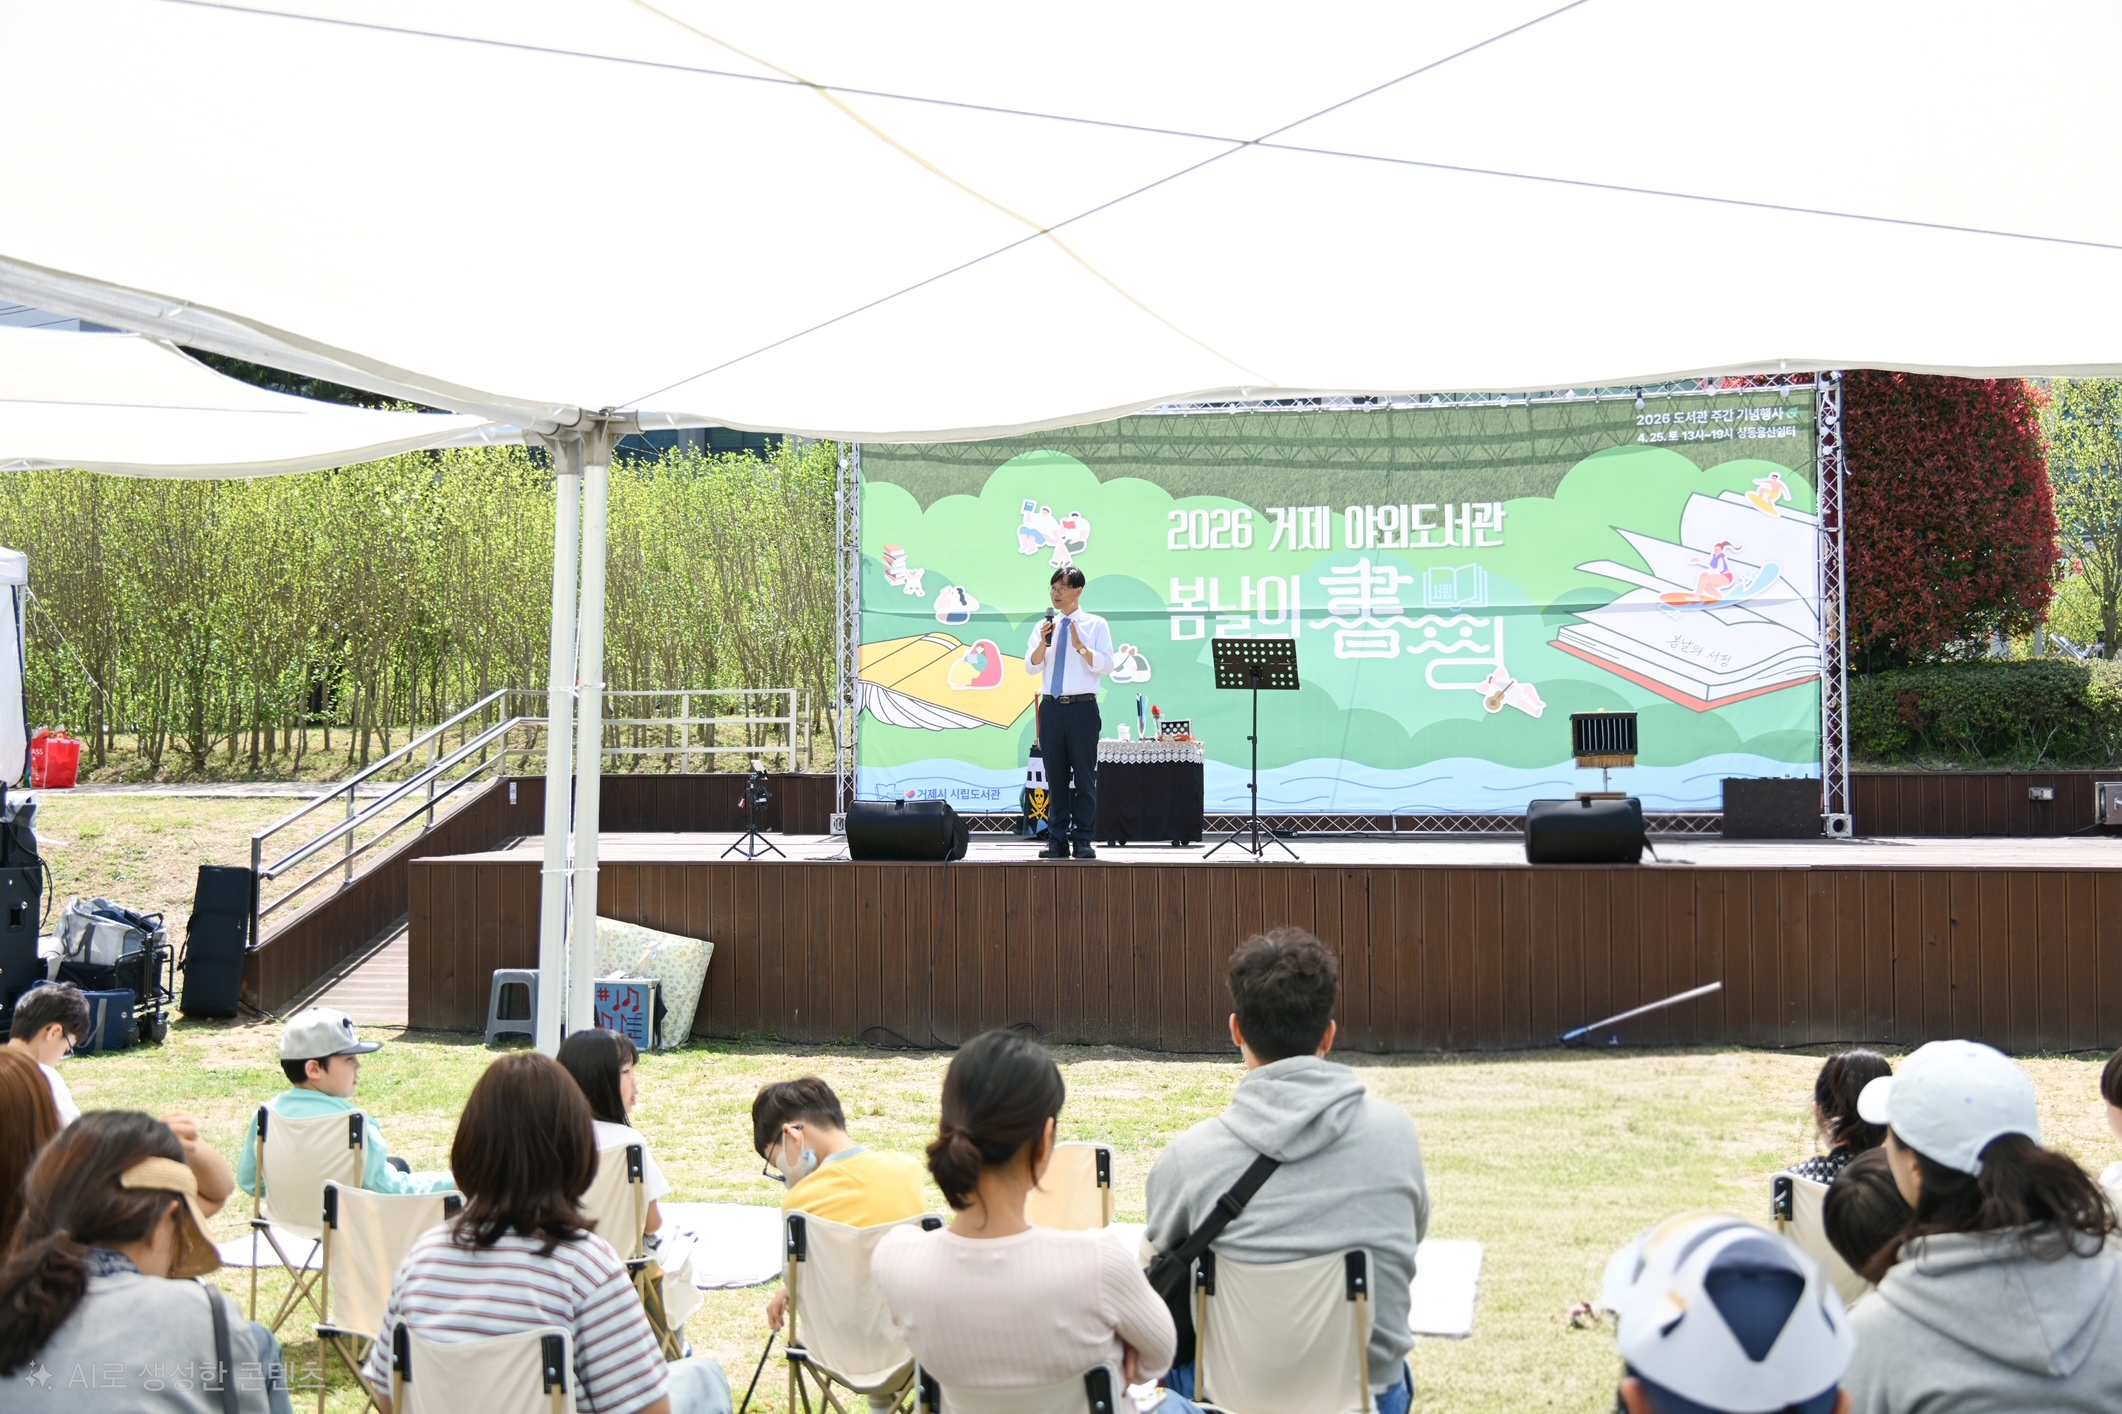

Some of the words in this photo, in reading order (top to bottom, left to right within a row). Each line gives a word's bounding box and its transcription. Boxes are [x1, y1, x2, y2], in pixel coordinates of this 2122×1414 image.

[1636, 413, 1671, 426] 2026
[1673, 411, 1708, 424] 도서관
[1710, 409, 1734, 423] 주간
[1737, 407, 1784, 421] 기념행사
[1668, 430, 1679, 441] 토
[1681, 427, 1733, 441] 13시~19시
[1737, 425, 1796, 439] 상동용산쉼터
[1167, 509, 1253, 551] 2026
[1266, 505, 1331, 551] 거제
[1345, 502, 1506, 549] 야외도서관
[1432, 583, 1453, 600] 서핑
[1166, 575, 1302, 641] 봄날의
[1706, 650, 1732, 667] 서핑
[917, 788, 947, 800] 거제시
[950, 788, 1001, 801] 시립도서관
